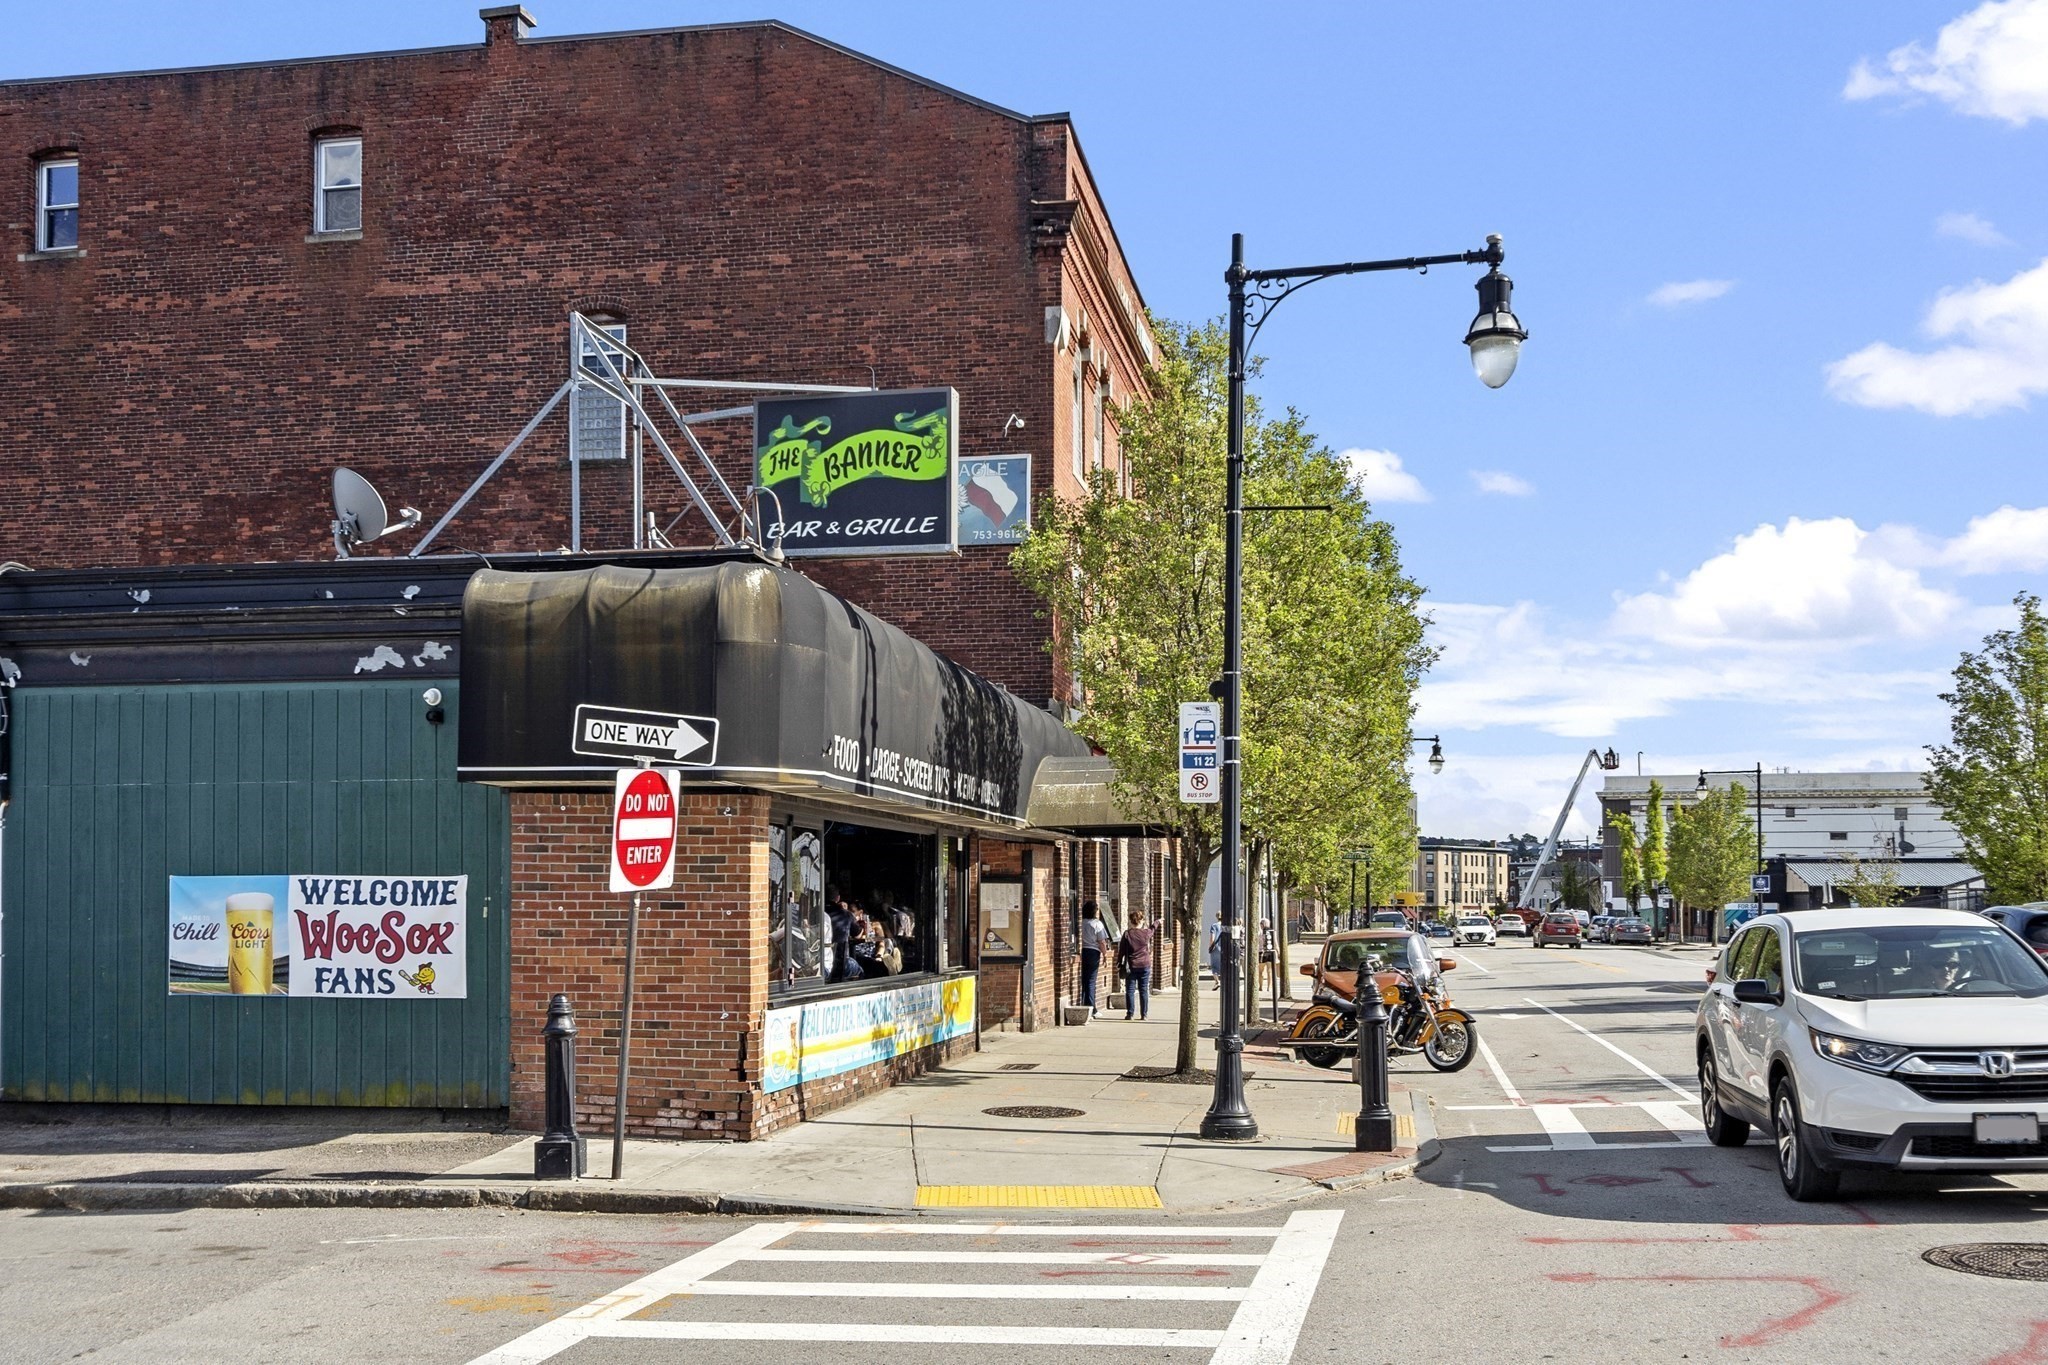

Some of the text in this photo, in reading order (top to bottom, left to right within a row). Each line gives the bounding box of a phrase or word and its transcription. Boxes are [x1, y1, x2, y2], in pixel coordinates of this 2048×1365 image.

[769, 439, 922, 482] THE BANNER
[958, 462, 1008, 477] AGLE
[766, 516, 939, 540] BAR & GRILLE
[590, 722, 674, 747] ONE WAY
[833, 734, 860, 773] FOOD
[1193, 756, 1215, 766] 11 22
[625, 793, 670, 812] DO NOT
[626, 845, 662, 865] ENTER
[297, 878, 459, 907] WELCOME
[172, 922, 221, 941] Chill
[230, 922, 270, 940] Coors
[293, 909, 455, 965] WooSox
[235, 939, 266, 949] LIGHT
[314, 967, 396, 995] FANS
[821, 1005, 841, 1036] ICED
